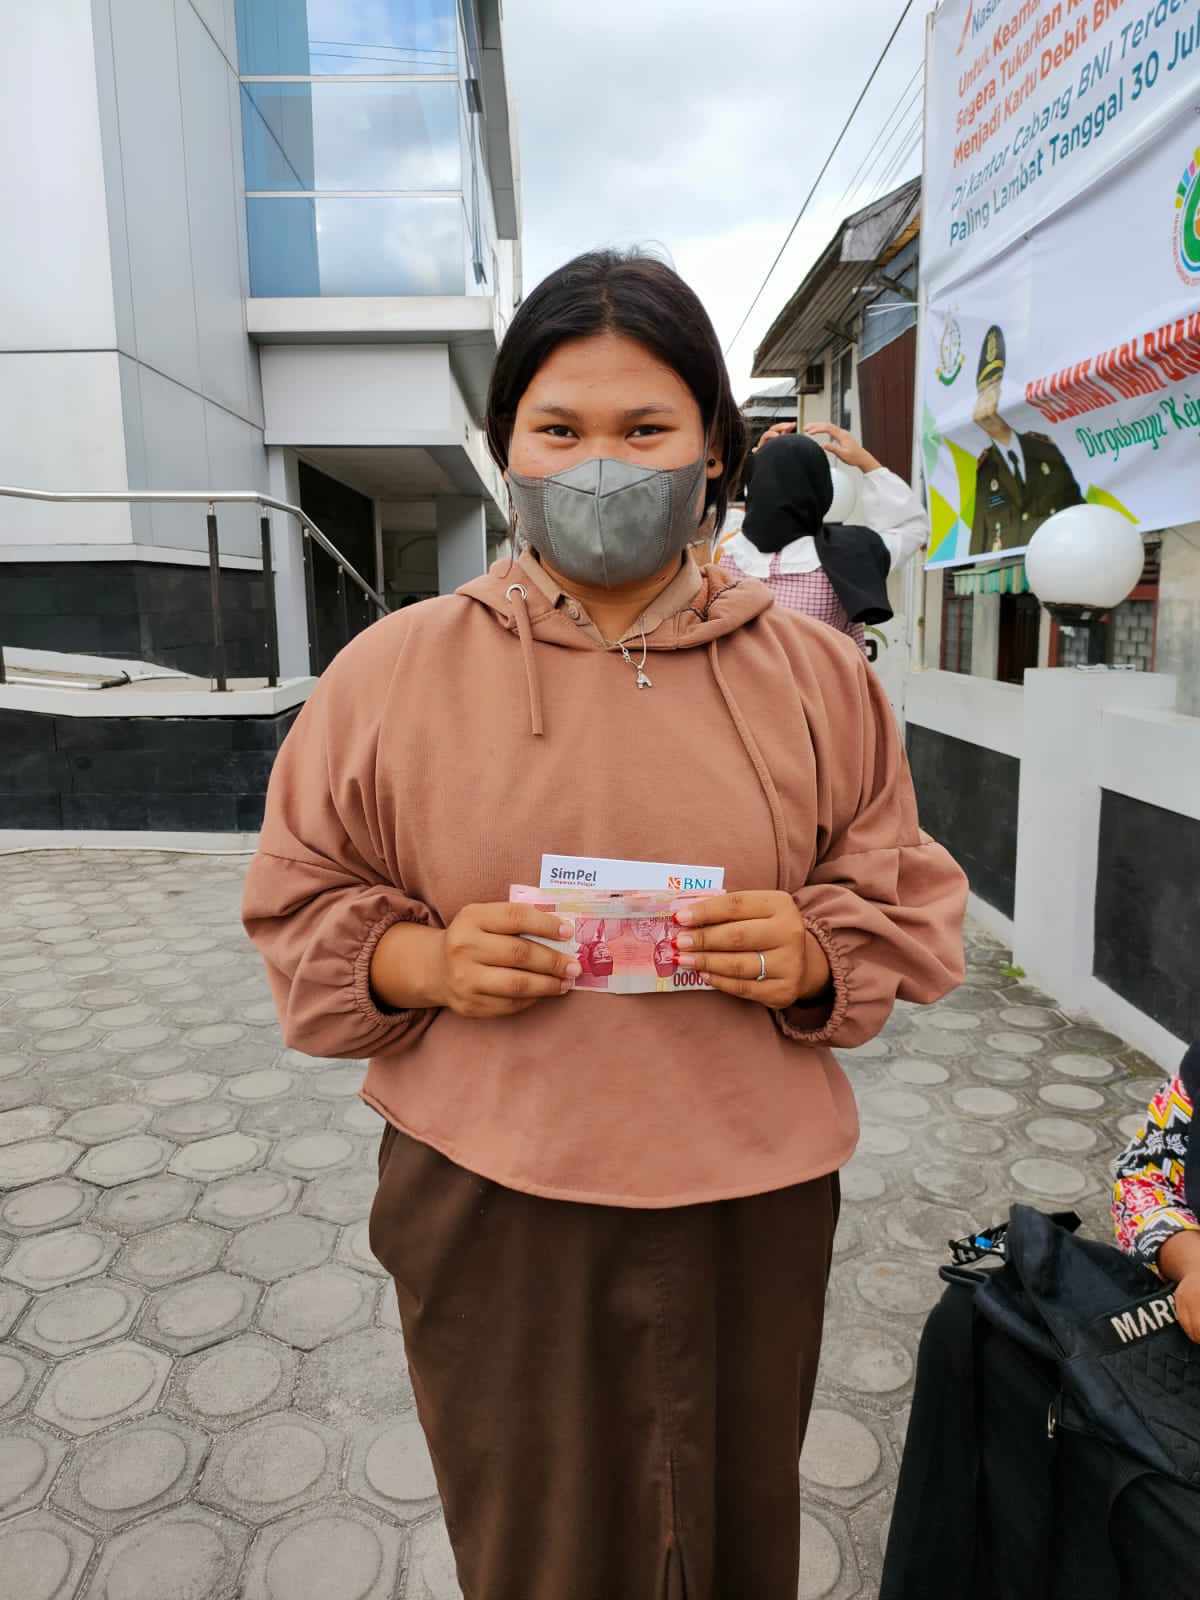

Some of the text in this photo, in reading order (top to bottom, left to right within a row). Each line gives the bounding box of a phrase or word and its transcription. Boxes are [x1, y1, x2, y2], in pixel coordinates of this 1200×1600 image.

[958, 43, 991, 98] Untuk
[1000, 2, 1062, 88] Tukarkan
[951, 179, 968, 211] Di
[1012, 84, 1073, 156] Cabang
[1078, 40, 1113, 98] BNI
[953, 103, 1001, 169] Menjadi
[1004, 68, 1038, 122] Kartu
[1040, 15, 1088, 80] Debit
[950, 201, 990, 247] Paling
[993, 148, 1044, 215] Lambat
[1049, 77, 1123, 166] Tanggal
[1131, 50, 1159, 101] 30
[1025, 357, 1118, 424] SELAMAT
[1095, 337, 1168, 400] HARI
[1075, 412, 1168, 462] Dirgahayu
[550, 867, 597, 882] SimPel
[683, 877, 713, 890] BNI
